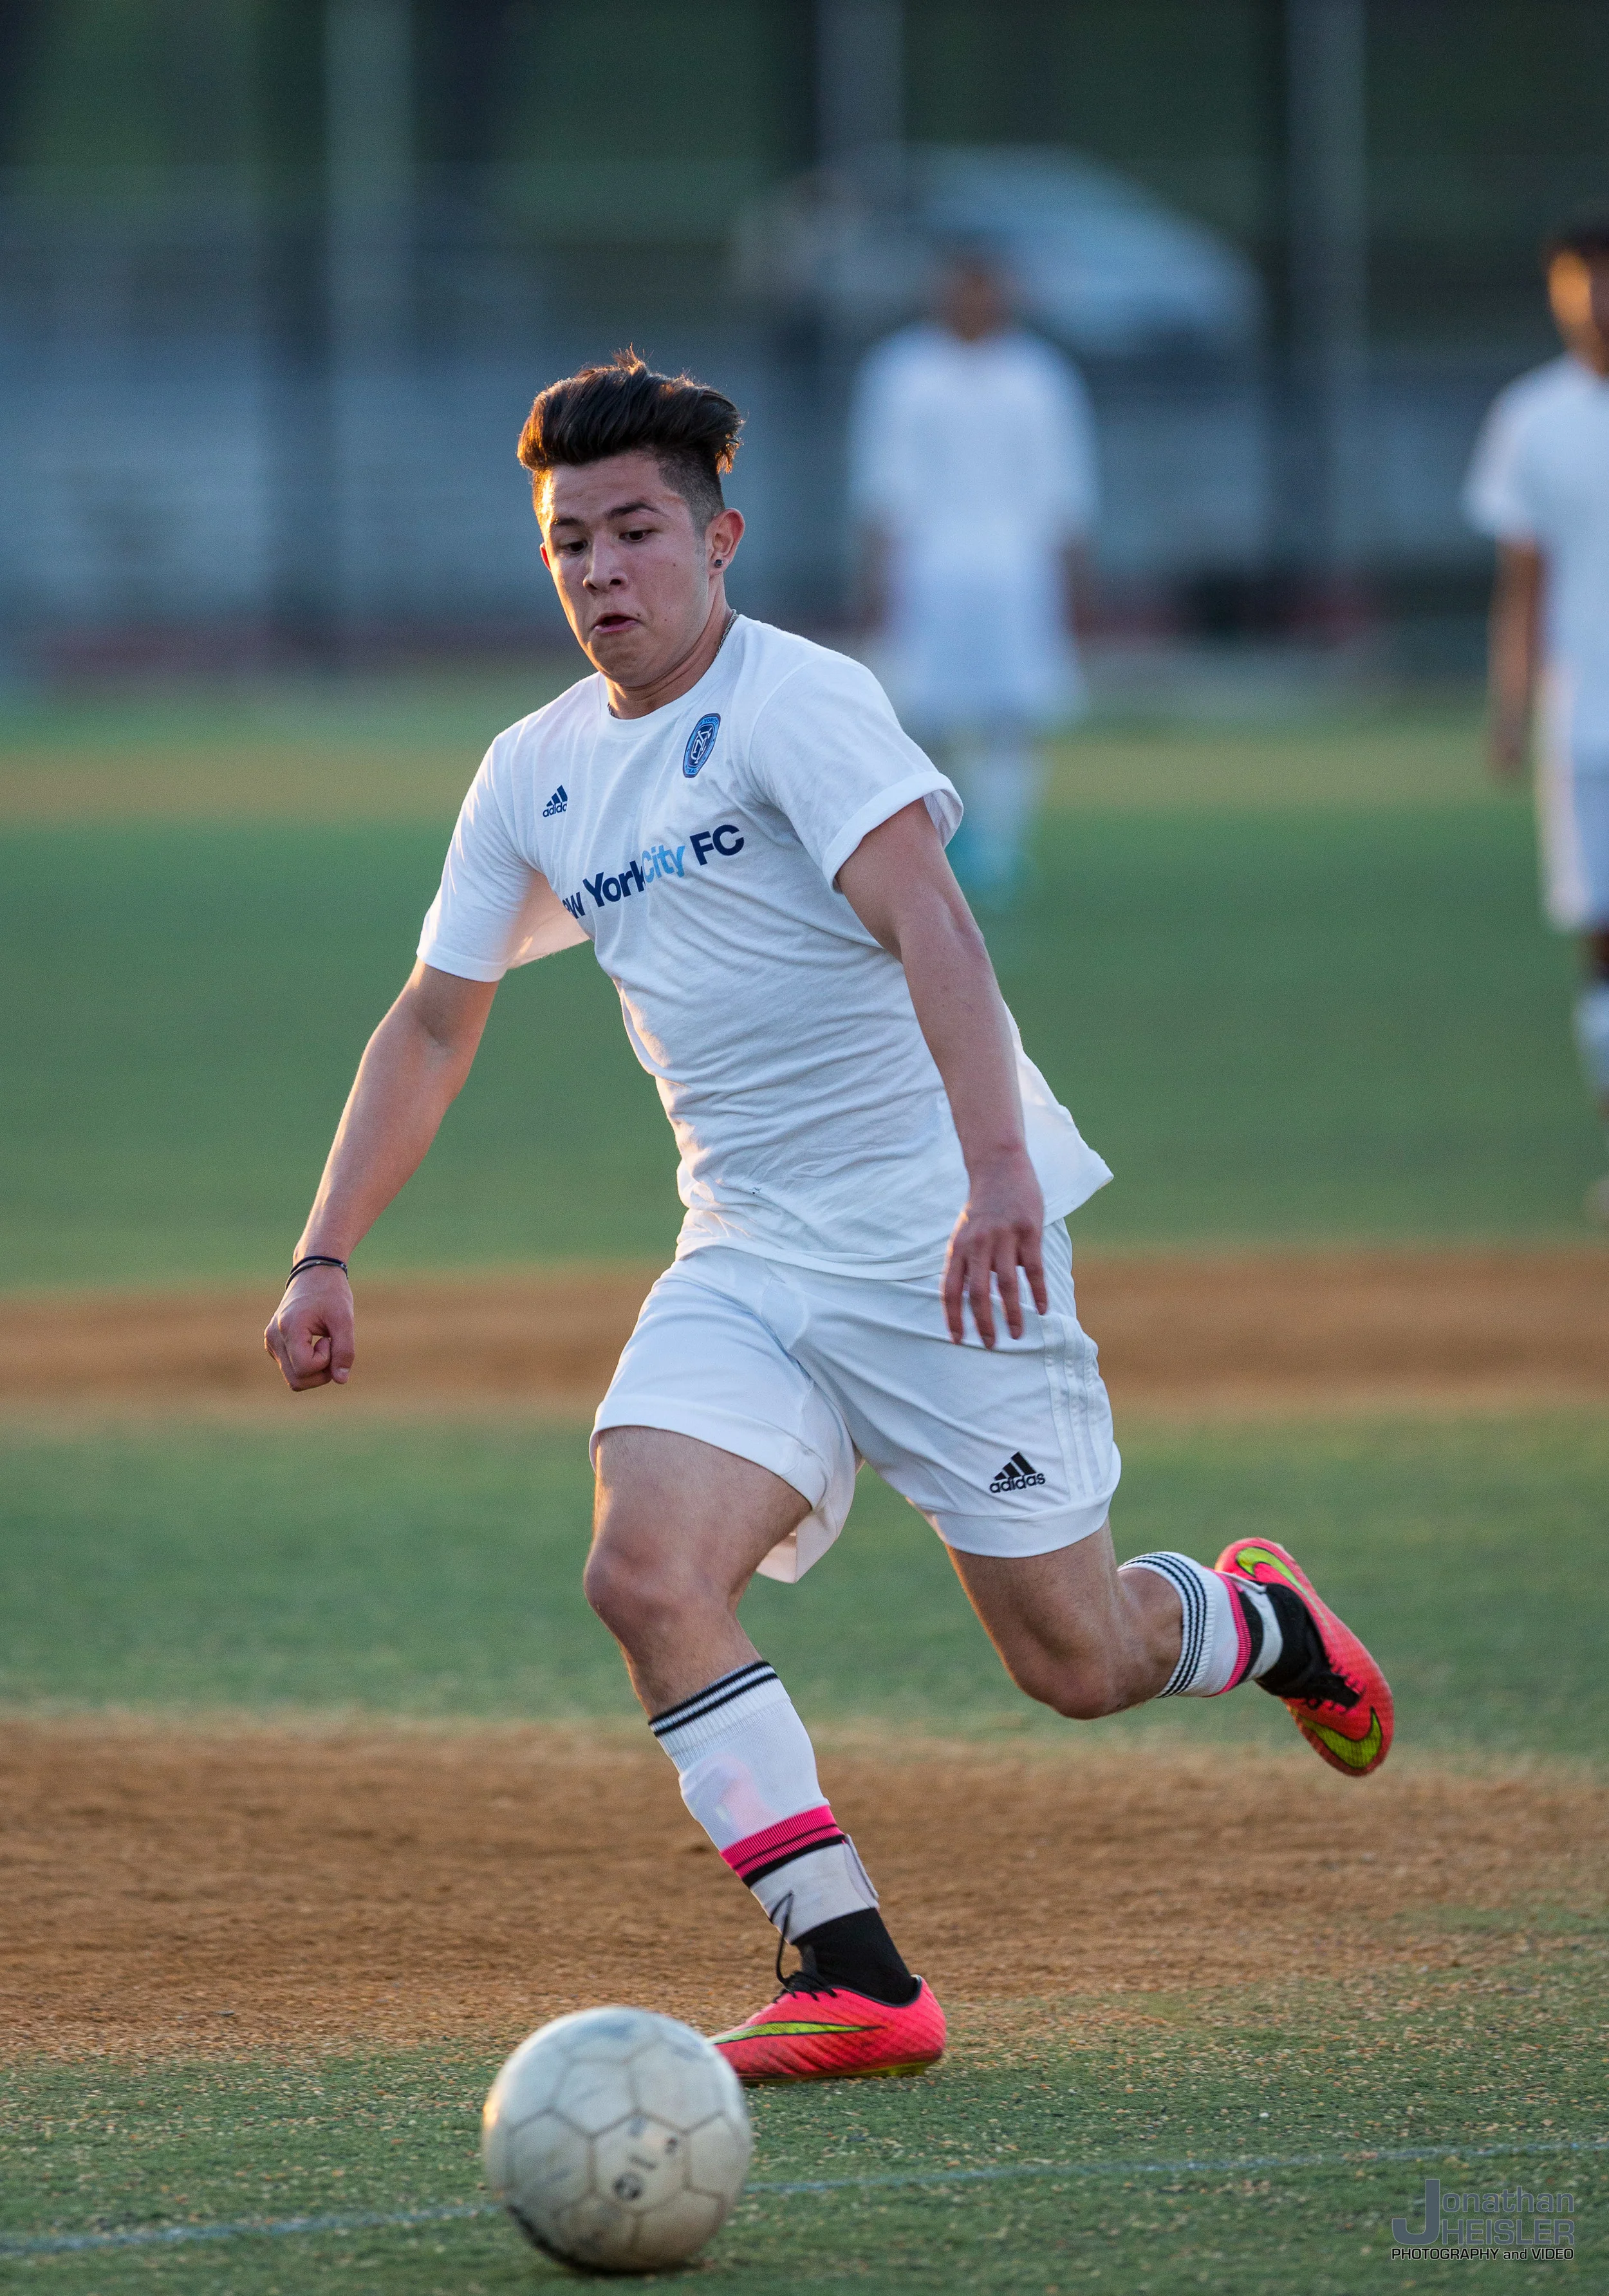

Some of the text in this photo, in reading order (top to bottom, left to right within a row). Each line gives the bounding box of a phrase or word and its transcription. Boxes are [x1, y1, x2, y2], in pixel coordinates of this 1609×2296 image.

[543, 802, 567, 817] adida
[582, 860, 646, 908] York
[642, 845, 685, 883] City
[689, 824, 745, 866] FC
[989, 1473, 1046, 1493] adidas
